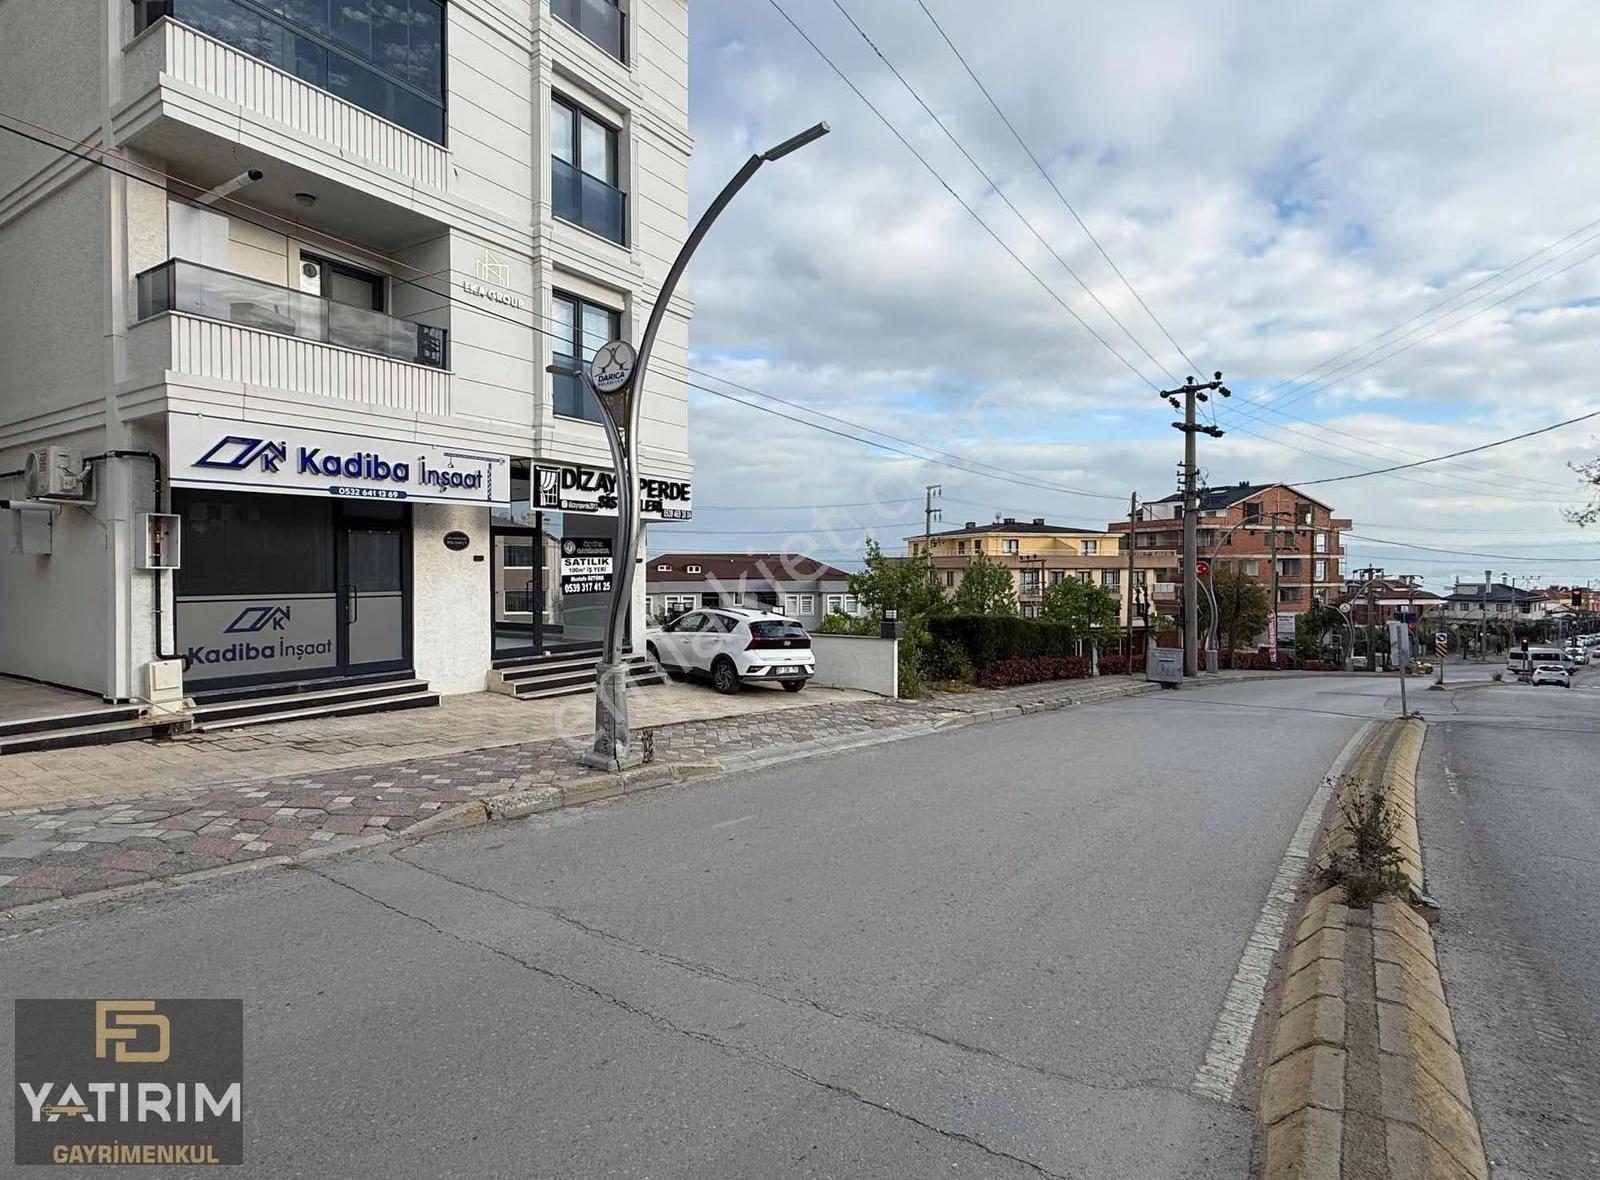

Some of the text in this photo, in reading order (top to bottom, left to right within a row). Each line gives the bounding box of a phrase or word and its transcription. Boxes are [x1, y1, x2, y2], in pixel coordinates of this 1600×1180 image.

[488, 290, 524, 308] GROUP
[598, 371, 625, 382] DARICA
[297, 447, 484, 493] Kadiba İnşaat
[560, 466, 691, 501] DİZAY PERDE
[338, 487, 360, 496] 0532
[361, 489, 377, 497] 641
[378, 490, 387, 498] 13
[564, 558, 609, 567] SATILIK
[564, 581, 611, 593] 0539 317 41 25
[188, 636, 333, 664] Kadiba İnşaat
